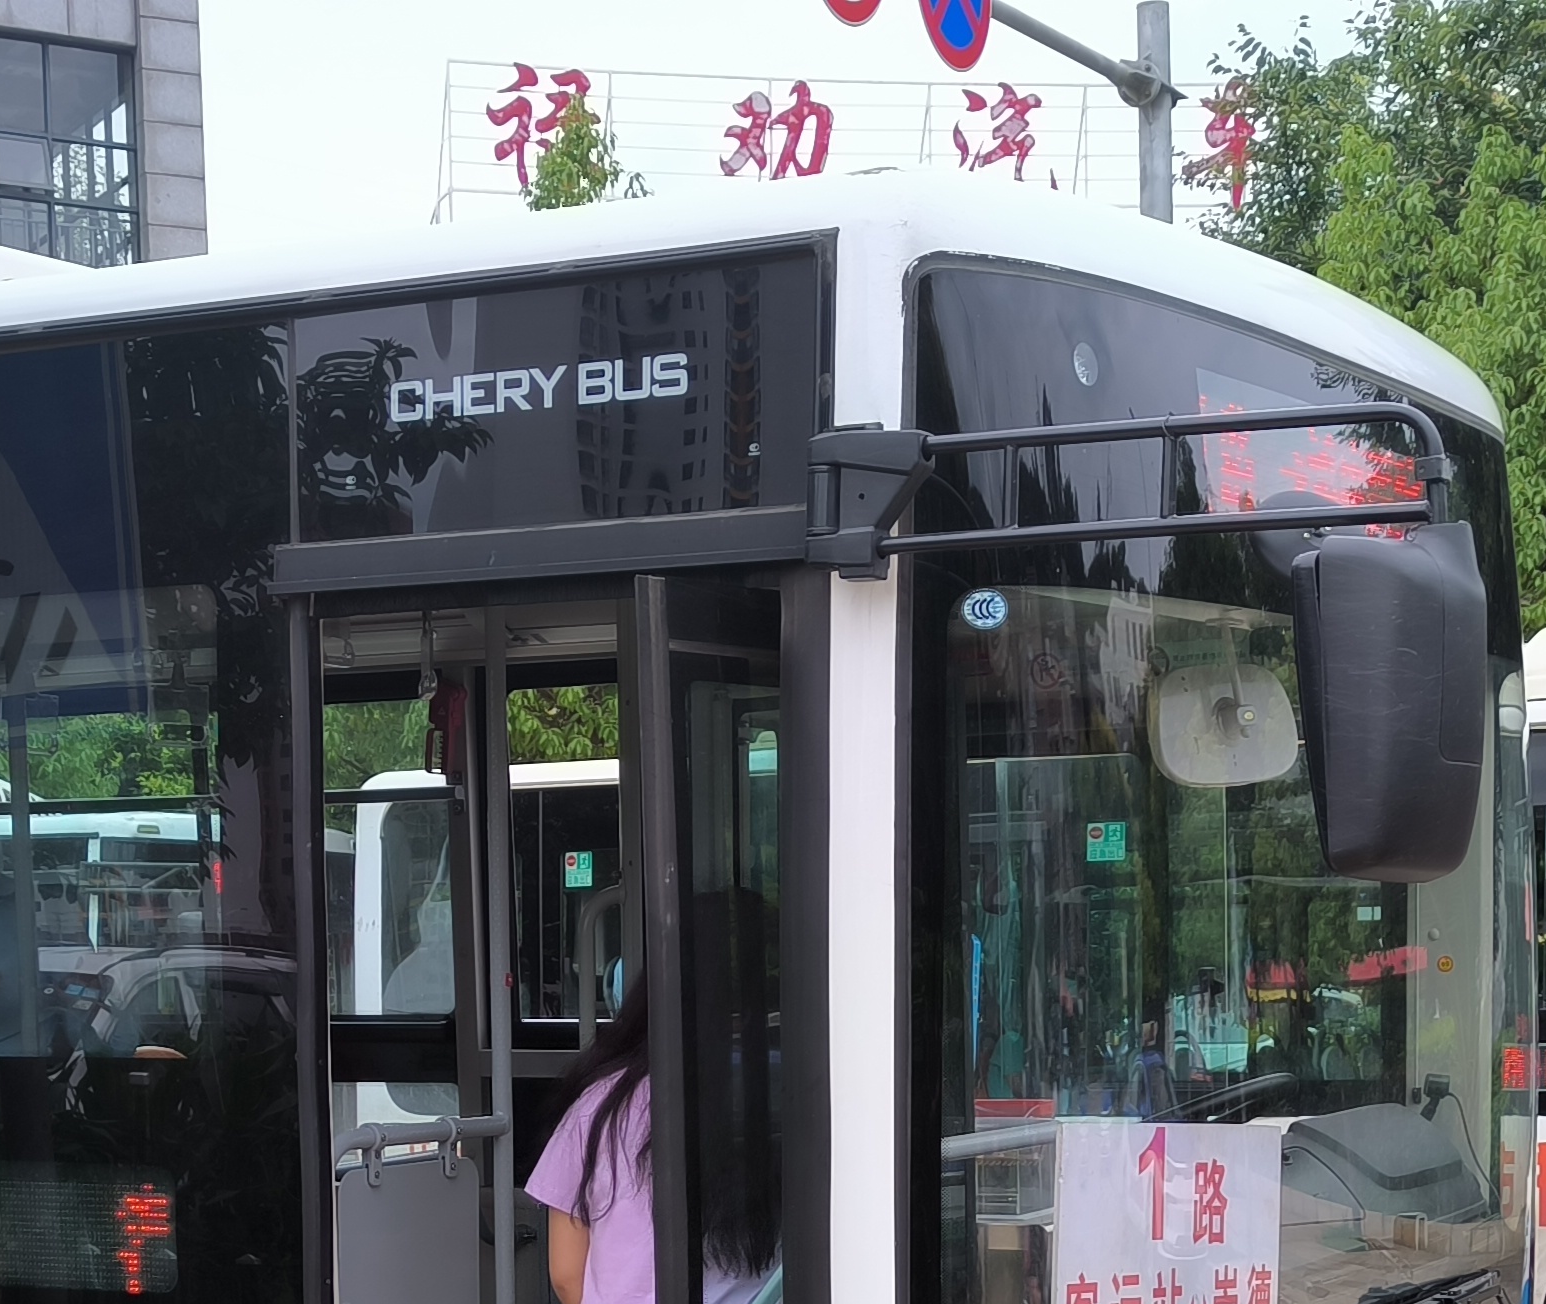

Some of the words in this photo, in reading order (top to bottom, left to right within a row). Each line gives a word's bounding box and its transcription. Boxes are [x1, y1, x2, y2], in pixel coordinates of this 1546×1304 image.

[390, 365, 567, 423] CHERY
[577, 353, 689, 405] BUS
[1138, 1127, 1229, 1246] 1路
